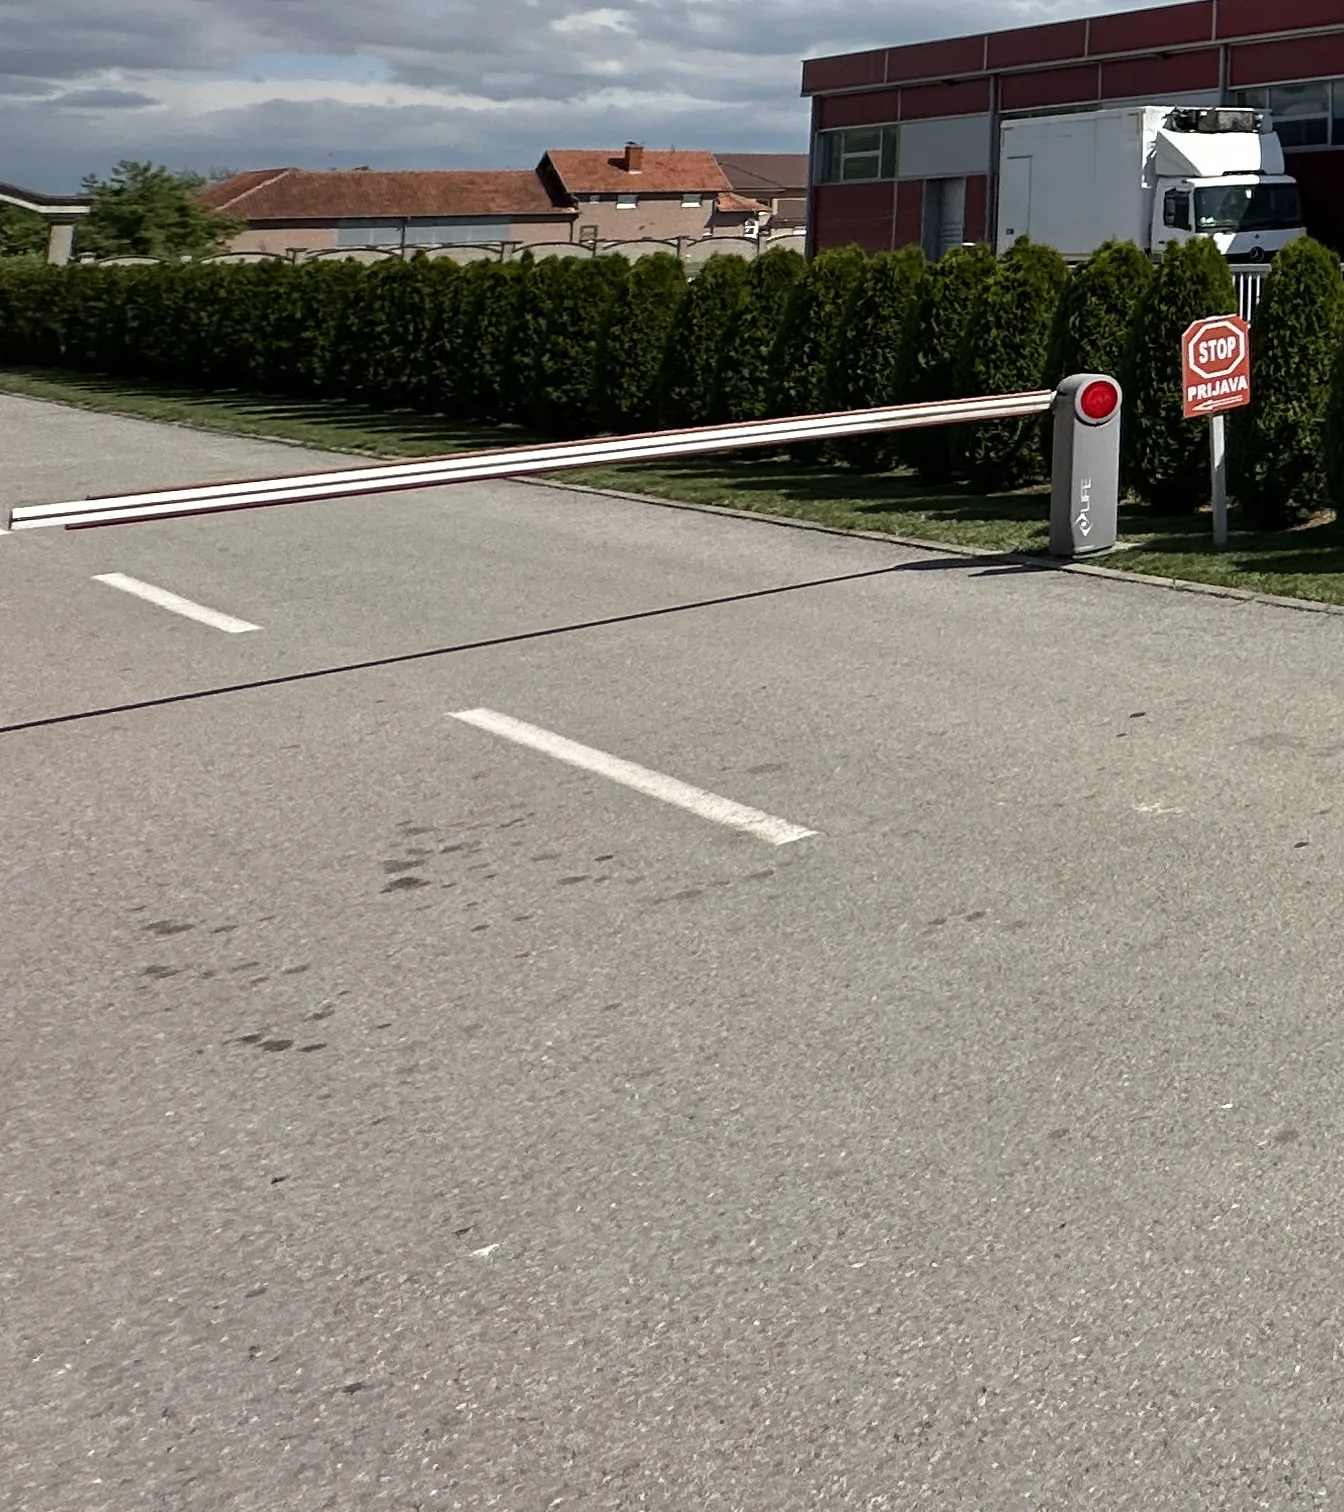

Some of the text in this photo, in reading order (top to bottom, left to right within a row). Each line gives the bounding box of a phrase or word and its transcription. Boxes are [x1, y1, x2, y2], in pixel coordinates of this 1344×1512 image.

[1199, 336, 1236, 364] STOP
[1187, 375, 1248, 402] PRIJAVA
[1080, 476, 1092, 513] LIFE
